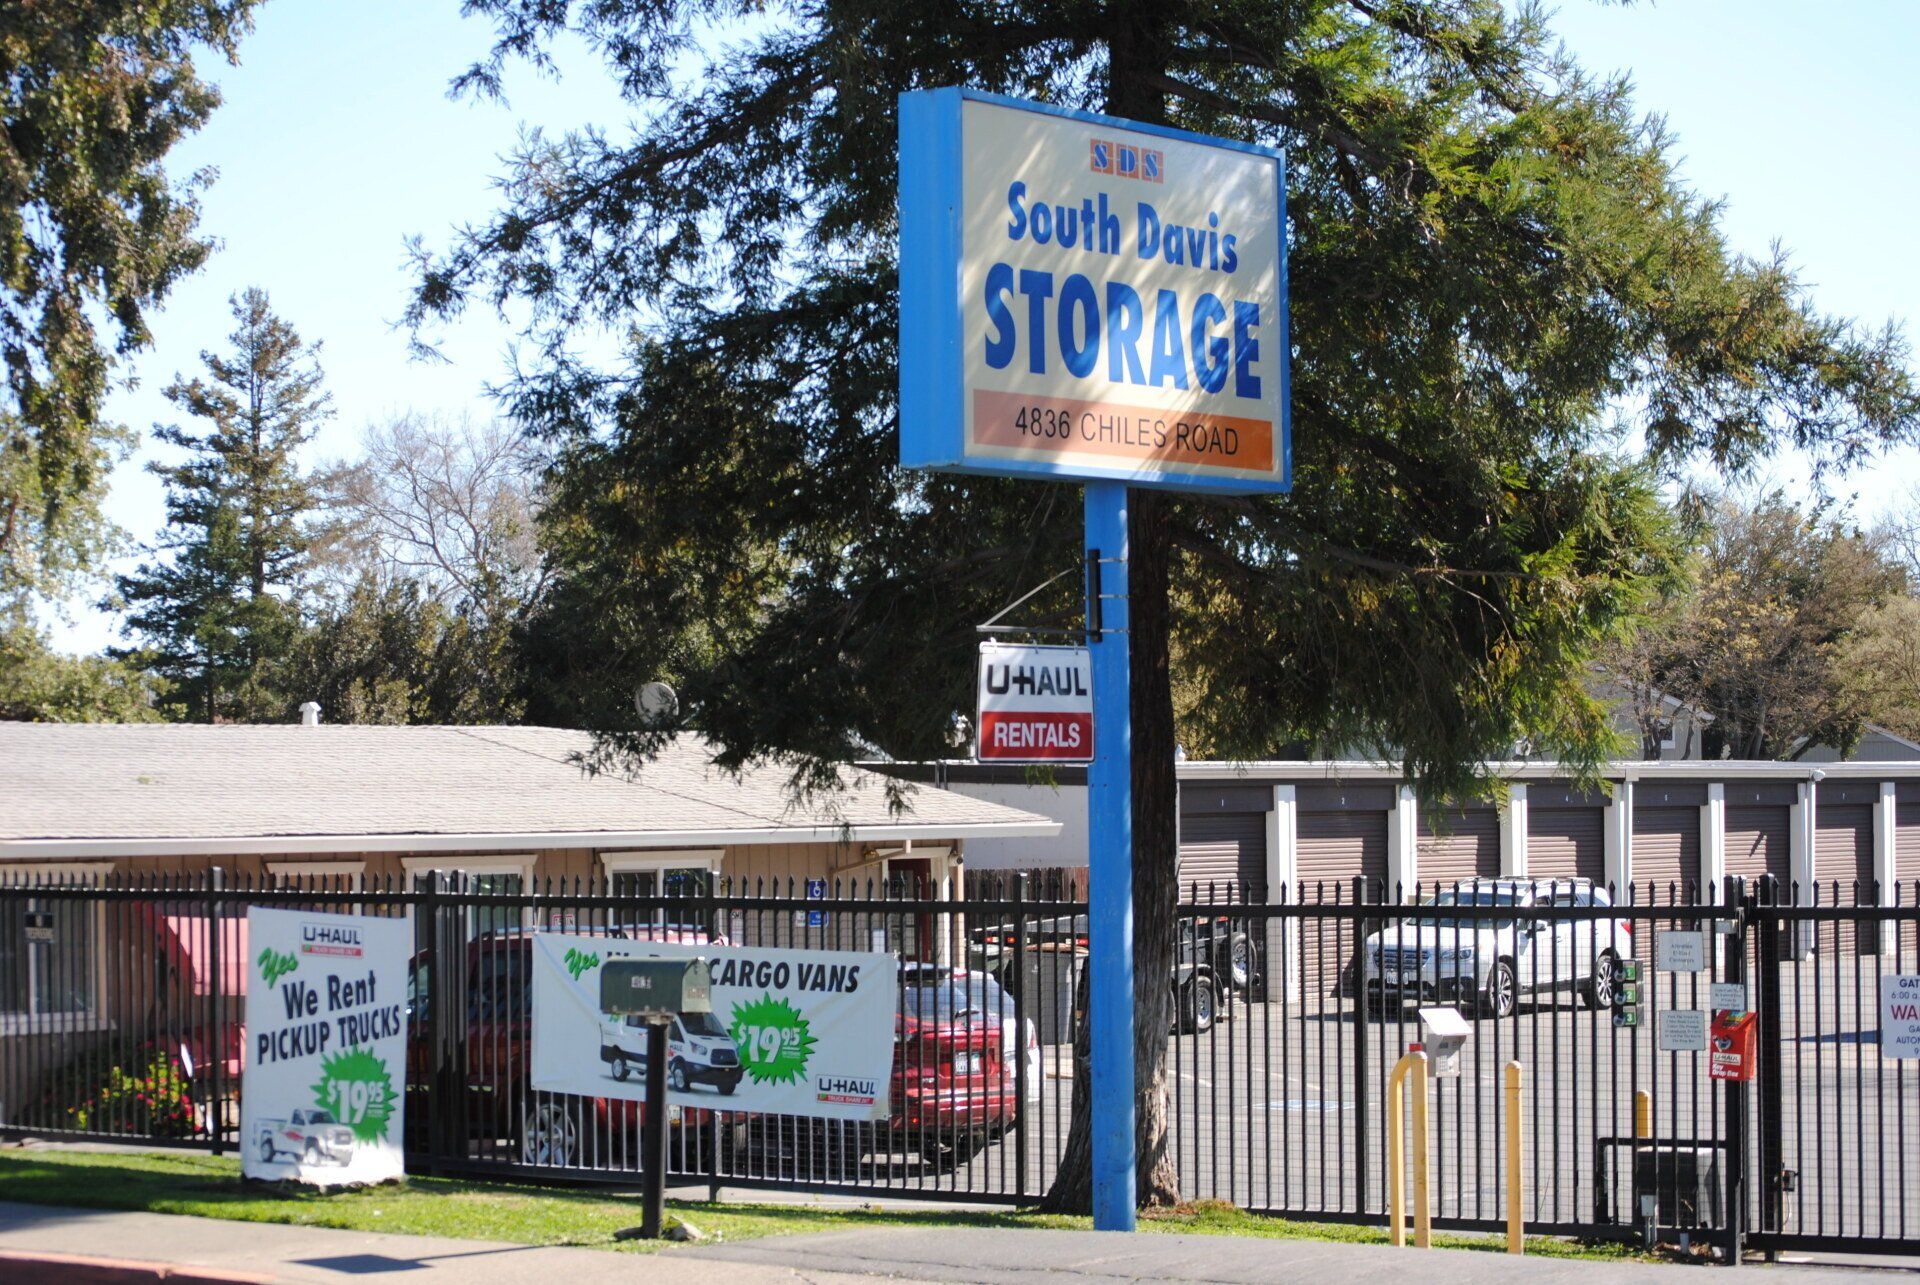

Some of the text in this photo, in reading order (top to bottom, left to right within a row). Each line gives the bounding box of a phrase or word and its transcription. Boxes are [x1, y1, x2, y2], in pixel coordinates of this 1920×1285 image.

[1093, 142, 1161, 180] SDS
[1008, 180, 1238, 274] South Davis
[984, 262, 1262, 400] STORAGE
[1015, 406, 1238, 456] 4836 CHILES ROAD
[987, 664, 1088, 696] U-HAUL
[994, 722, 1080, 748] RENTALS
[304, 926, 361, 945] U-HAUL
[257, 947, 299, 989] Yes
[563, 947, 600, 981] Yes
[709, 957, 861, 994] CARGO VANS
[282, 970, 376, 1020] We Rent
[1891, 1005, 1920, 1020] WA
[257, 1004, 401, 1065] PICKUP TRUCKS
[1626, 1013, 1633, 1022] 3
[819, 1078, 875, 1095] U-HAUL
